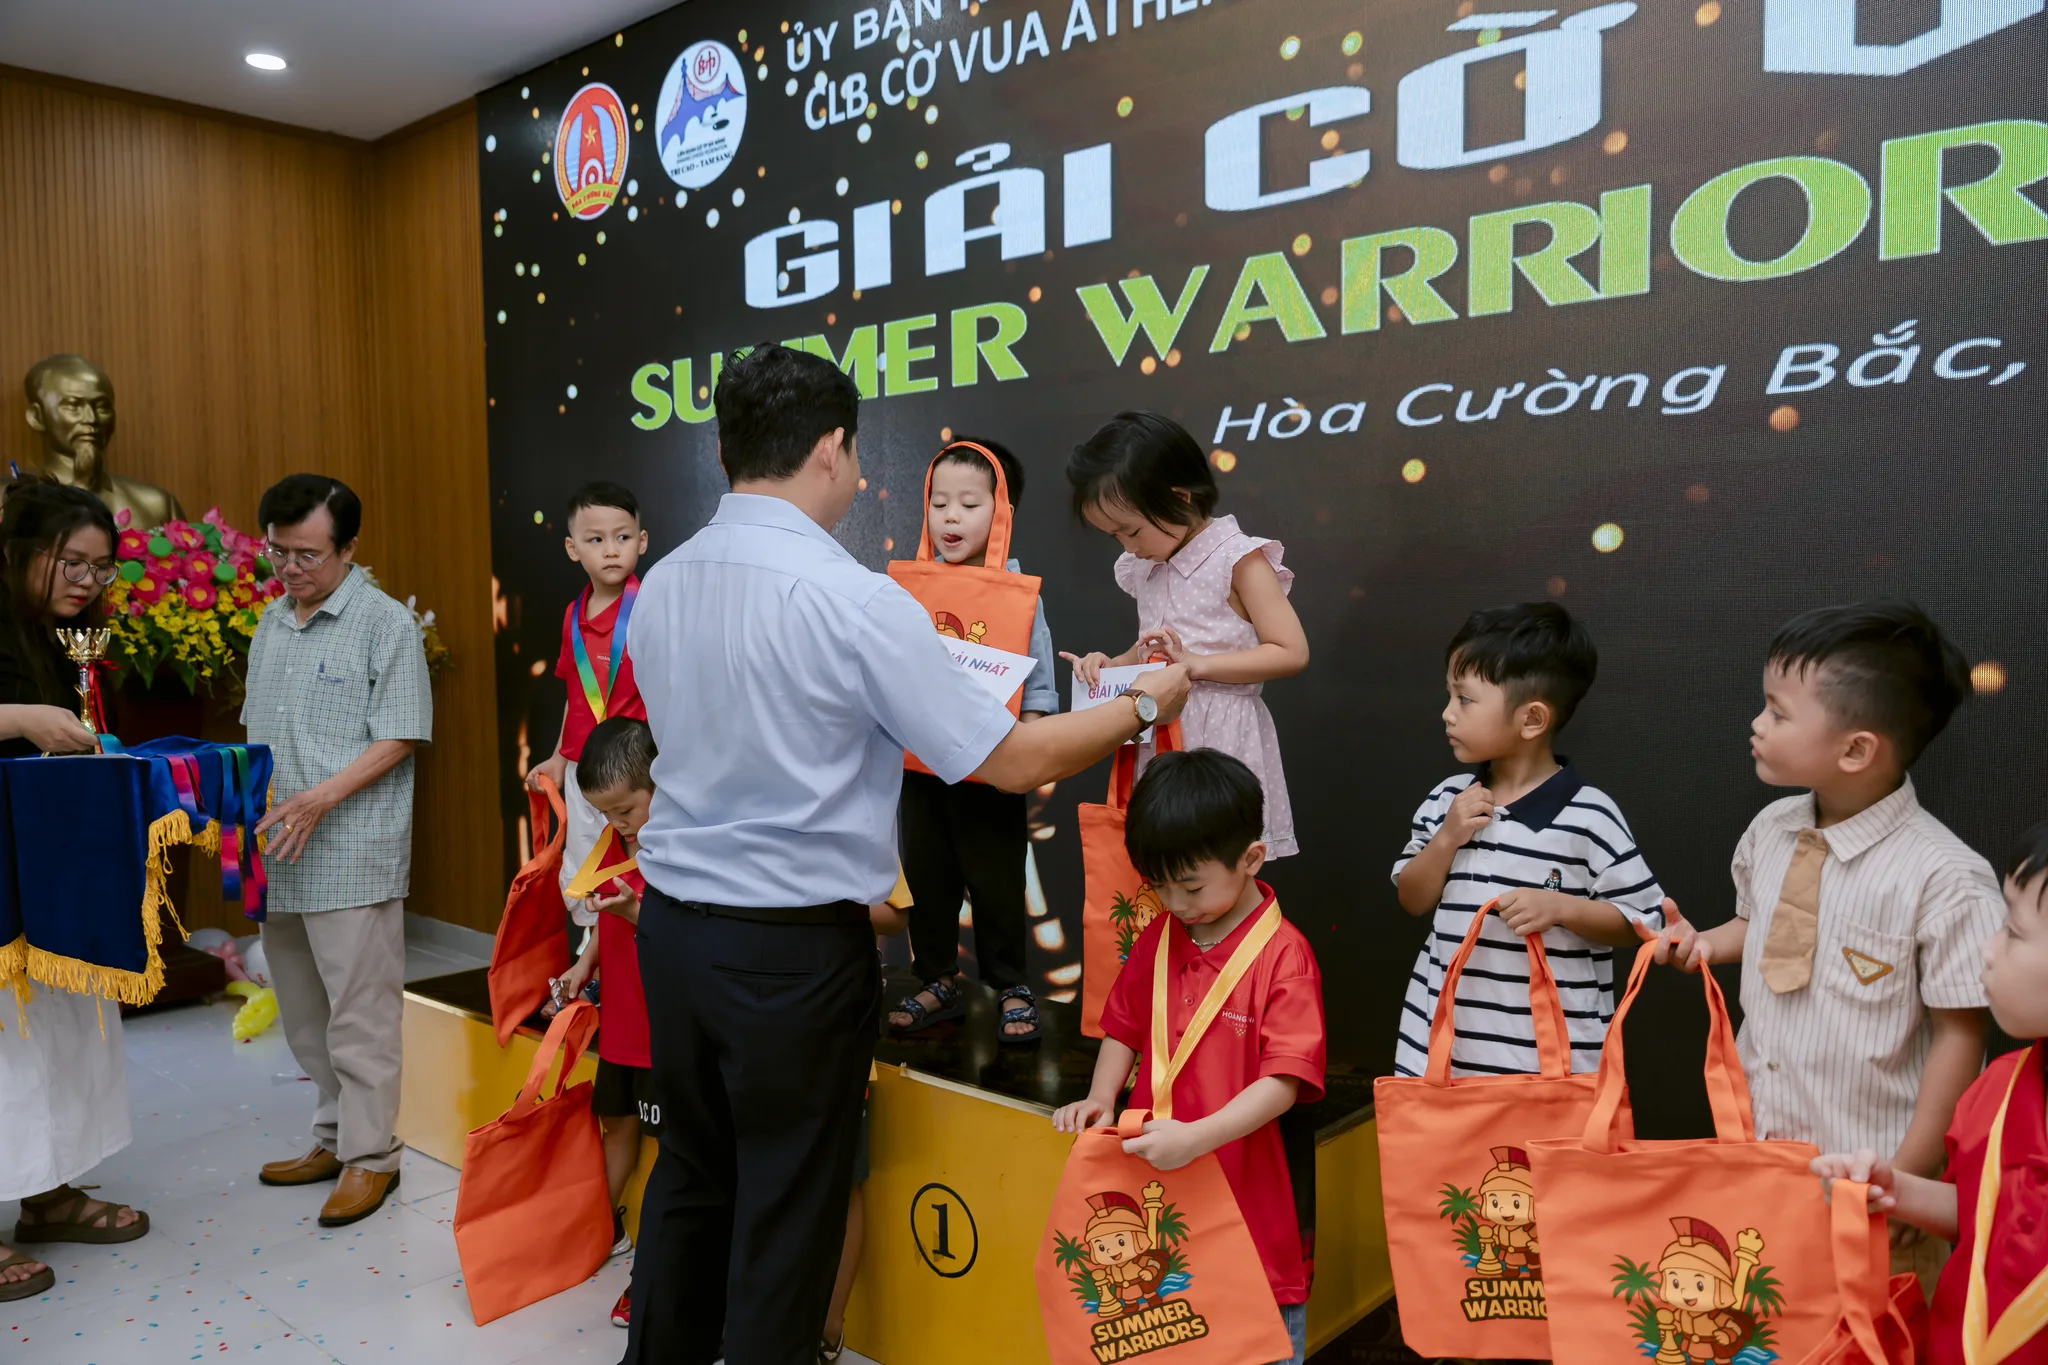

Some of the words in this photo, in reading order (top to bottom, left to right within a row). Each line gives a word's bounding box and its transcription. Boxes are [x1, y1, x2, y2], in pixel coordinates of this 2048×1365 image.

[786, 21, 839, 73] ỦY
[804, 72, 870, 131] CLB
[881, 39, 943, 107] CỜ
[949, 10, 1051, 83] VUA
[744, 142, 1112, 309] GIẢI
[1205, 1, 1638, 212] CỜ
[630, 302, 1029, 431] SUMER
[1213, 400, 1367, 445] Hòa
[1395, 364, 1728, 427] Cường
[1765, 319, 2027, 398] Bắc,
[968, 657, 1011, 677] NHẤT
[1088, 680, 1112, 700] GIẢI
[931, 1203, 956, 1260] 1
[1463, 1299, 1548, 1319] WARRI
[1468, 1280, 1545, 1298] SUMM
[1093, 1300, 1192, 1343] SUMMER
[1093, 1317, 1206, 1363] WARRIORS
